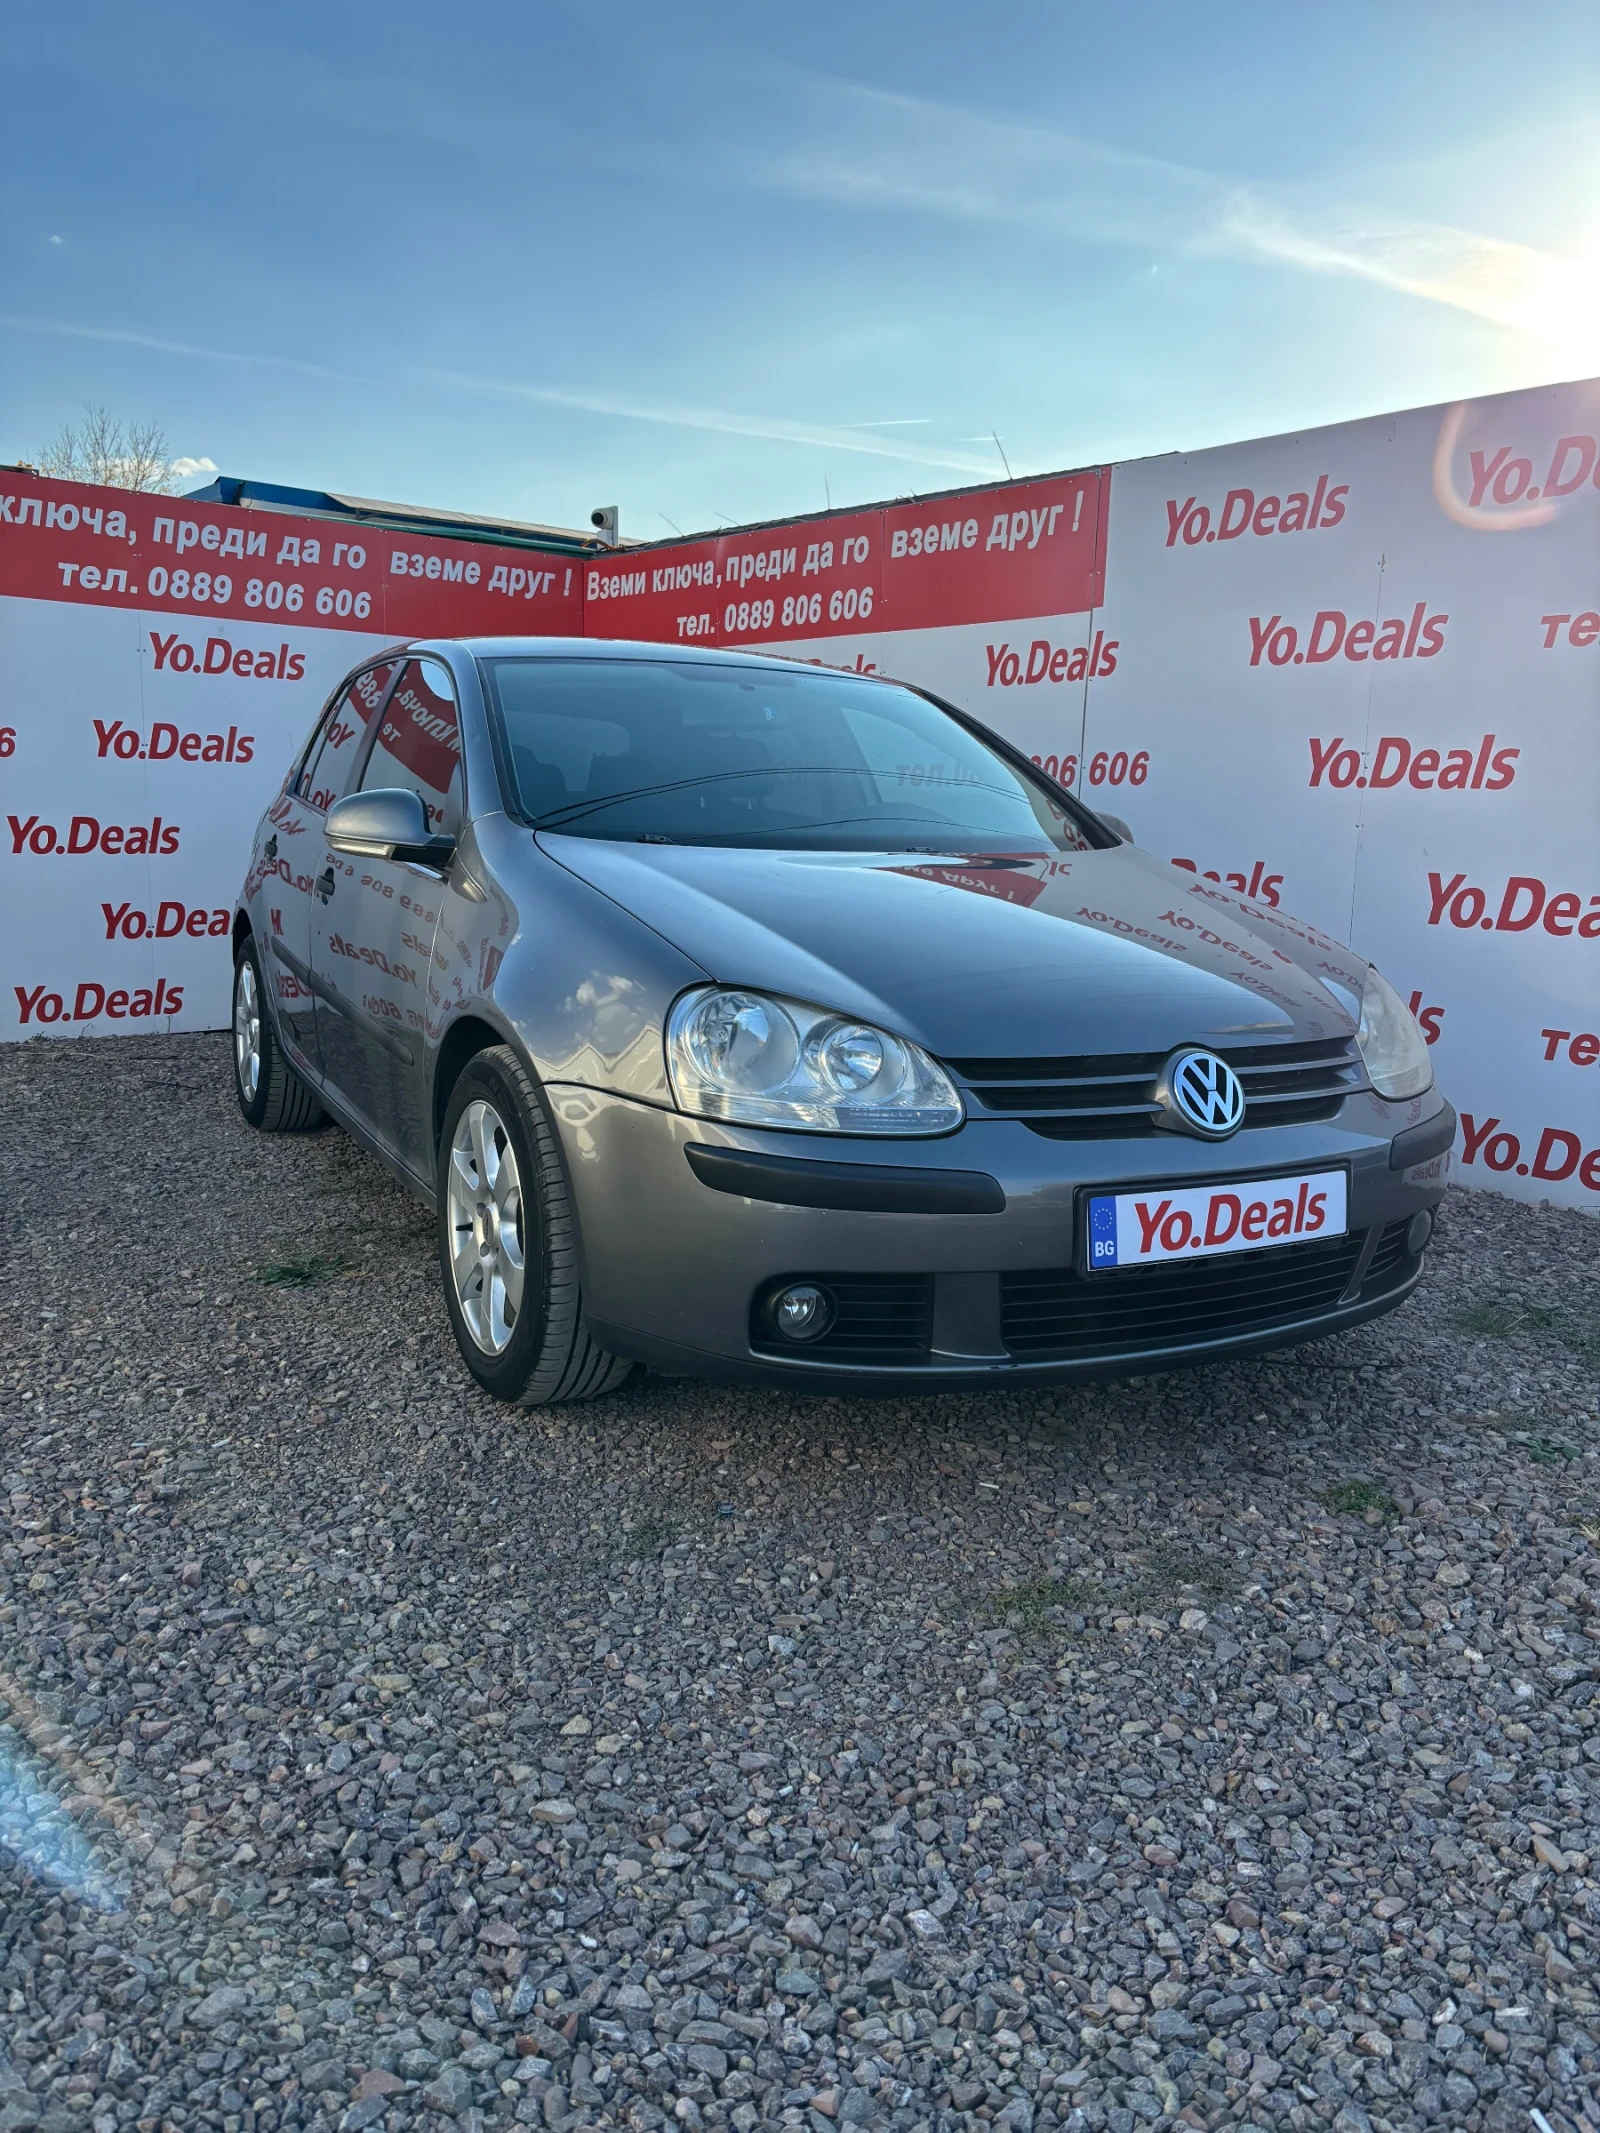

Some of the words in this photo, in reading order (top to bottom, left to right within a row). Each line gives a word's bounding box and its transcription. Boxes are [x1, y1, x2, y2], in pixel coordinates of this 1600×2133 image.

[1468, 435, 1600, 507] Yo.D
[1165, 475, 1349, 547] Yo.Deals
[153, 517, 267, 555] преди
[276, 536, 321, 567] да
[333, 543, 366, 569] го
[390, 551, 481, 584] вземе
[487, 565, 556, 599] друг
[587, 571, 646, 601] Вземи
[726, 547, 797, 588] преди
[802, 541, 834, 577] да
[842, 536, 869, 565] го
[891, 519, 978, 558] вземе
[985, 505, 1064, 551] друг
[58, 562, 138, 594] тел.
[148, 567, 233, 604] 0889
[244, 579, 304, 612] 806
[316, 587, 371, 619] 606
[677, 613, 715, 637] тел.
[724, 599, 774, 632] 0889
[781, 593, 822, 627] 806
[829, 586, 874, 622] 606
[149, 632, 305, 681] Yo.Deals
[986, 630, 1120, 687] Yo.Deals
[1249, 602, 1448, 666] Yo.Deals
[93, 720, 254, 763] Yo.Deals
[1089, 751, 1150, 786] 606
[1309, 734, 1520, 790] Yo.Deals
[7, 816, 180, 854] Yo.Deals
[14, 979, 184, 1024] Yo.Deals
[1135, 1182, 1328, 1254] Yo.Deals
[1095, 1240, 1115, 1257] BG
